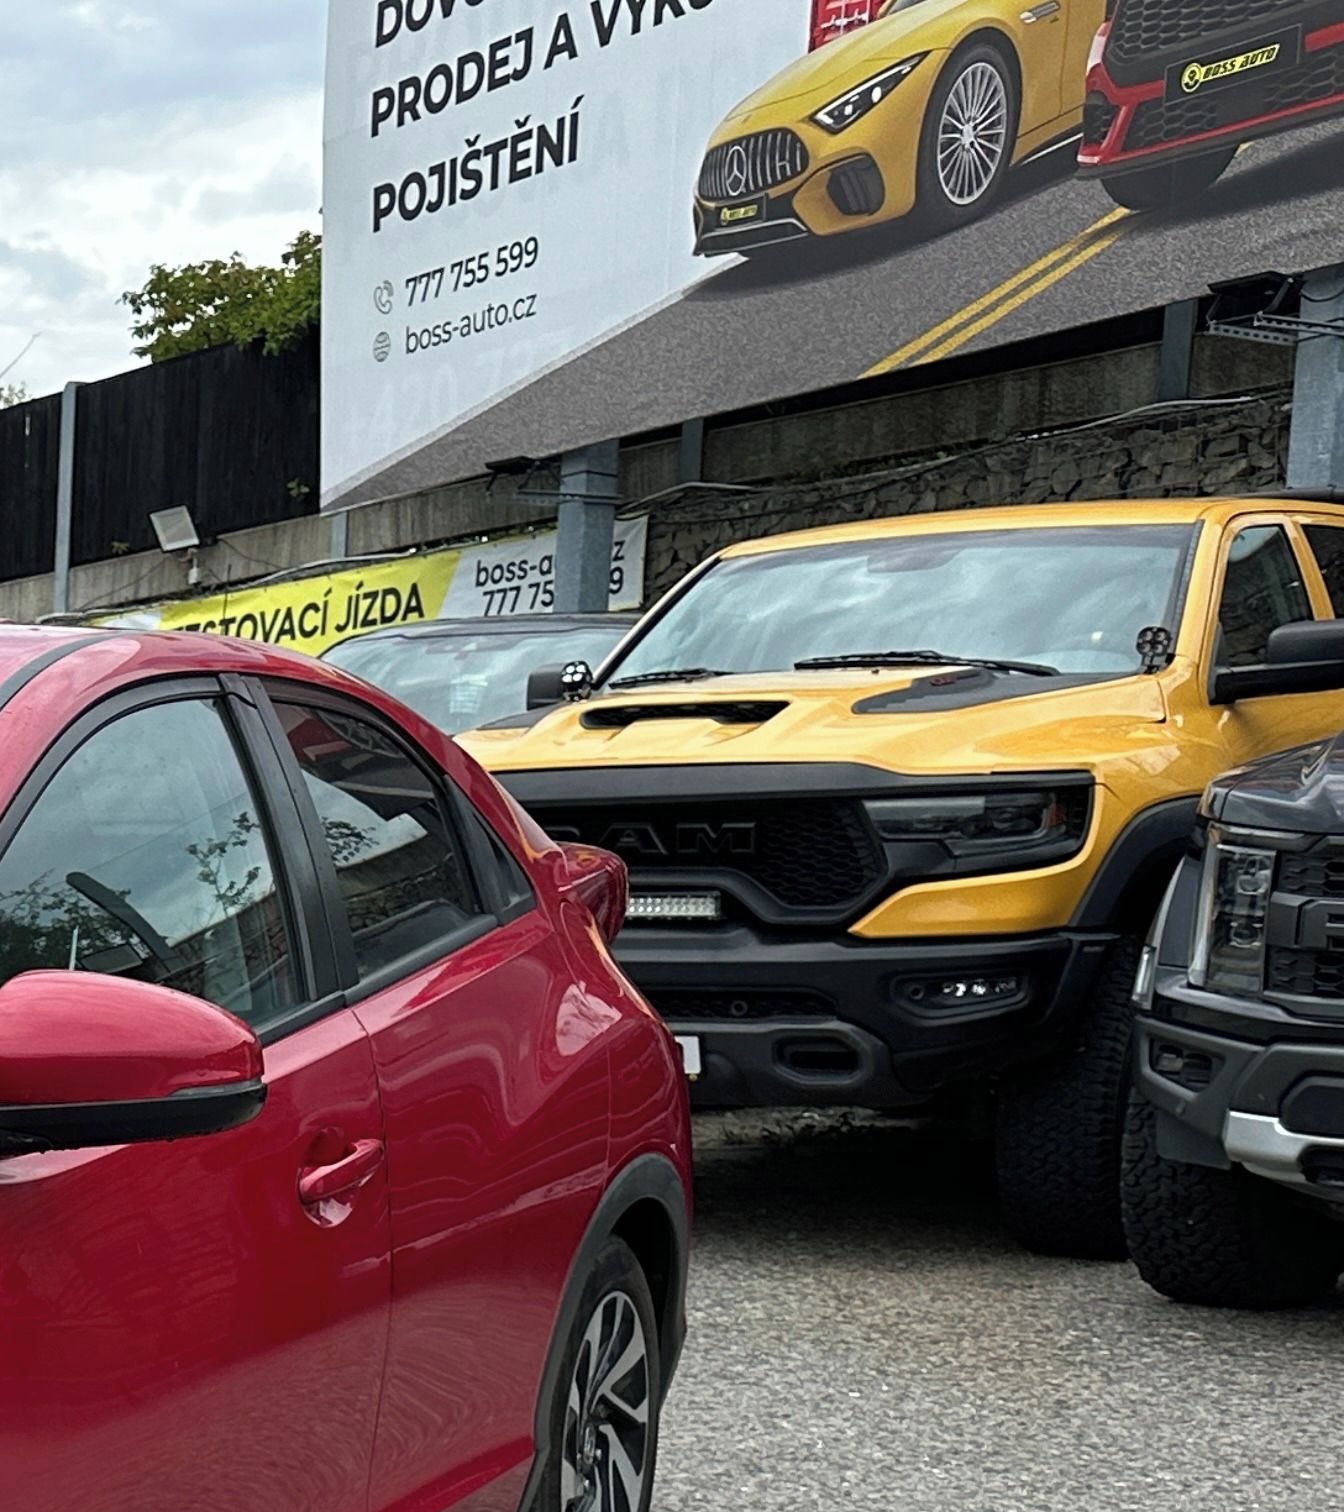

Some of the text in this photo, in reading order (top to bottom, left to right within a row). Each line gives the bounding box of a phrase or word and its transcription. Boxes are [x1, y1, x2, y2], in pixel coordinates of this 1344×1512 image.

[371, 26, 534, 138] PRODEJ
[543, 12, 579, 70] A
[373, 94, 585, 233] POJIŠTĚNÍ
[405, 236, 539, 307] 777 755 599
[405, 294, 537, 355] boss-auto.cz
[335, 581, 424, 632] JÍZDA
[483, 586, 521, 616] 777
